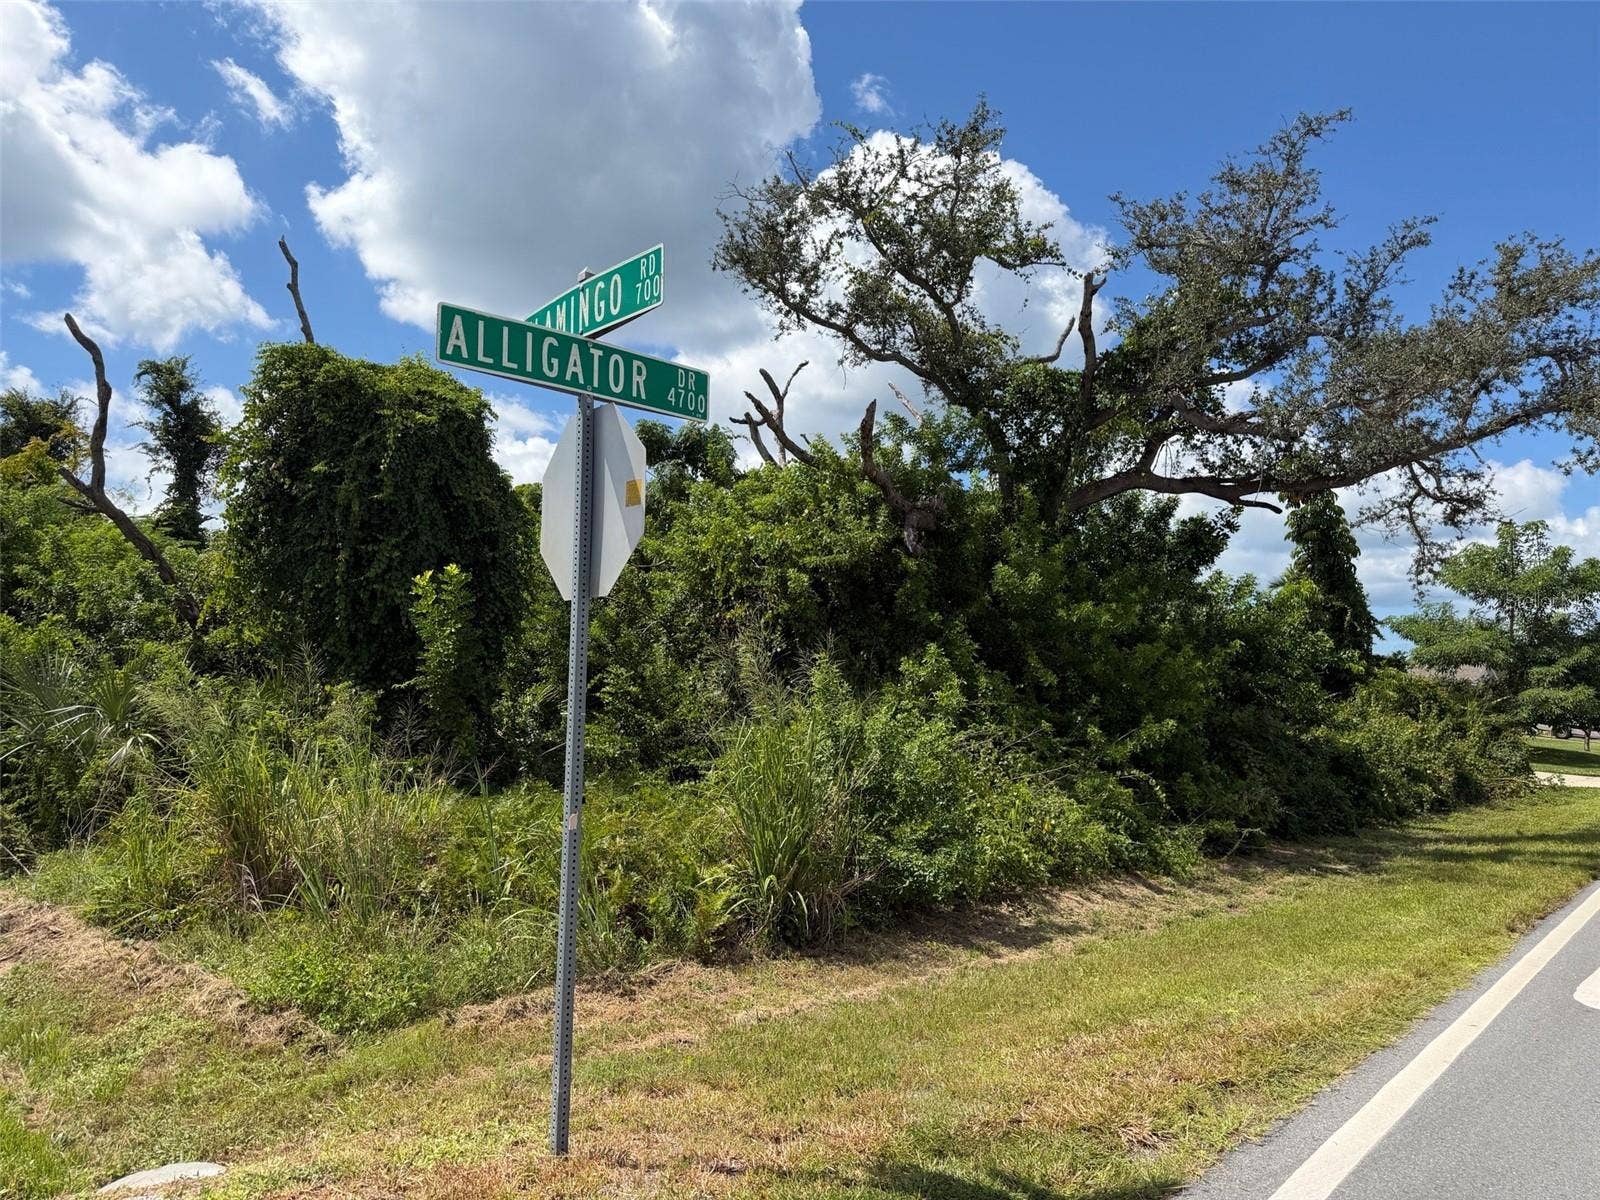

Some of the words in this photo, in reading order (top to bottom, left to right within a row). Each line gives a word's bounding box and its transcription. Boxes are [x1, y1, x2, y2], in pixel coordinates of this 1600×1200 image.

[531, 273, 622, 334] AMINGO
[640, 253, 656, 280] RD
[635, 276, 660, 305] 700
[445, 314, 648, 400] ALLIGATOR
[678, 368, 696, 391] DR
[667, 387, 706, 414] 4700
